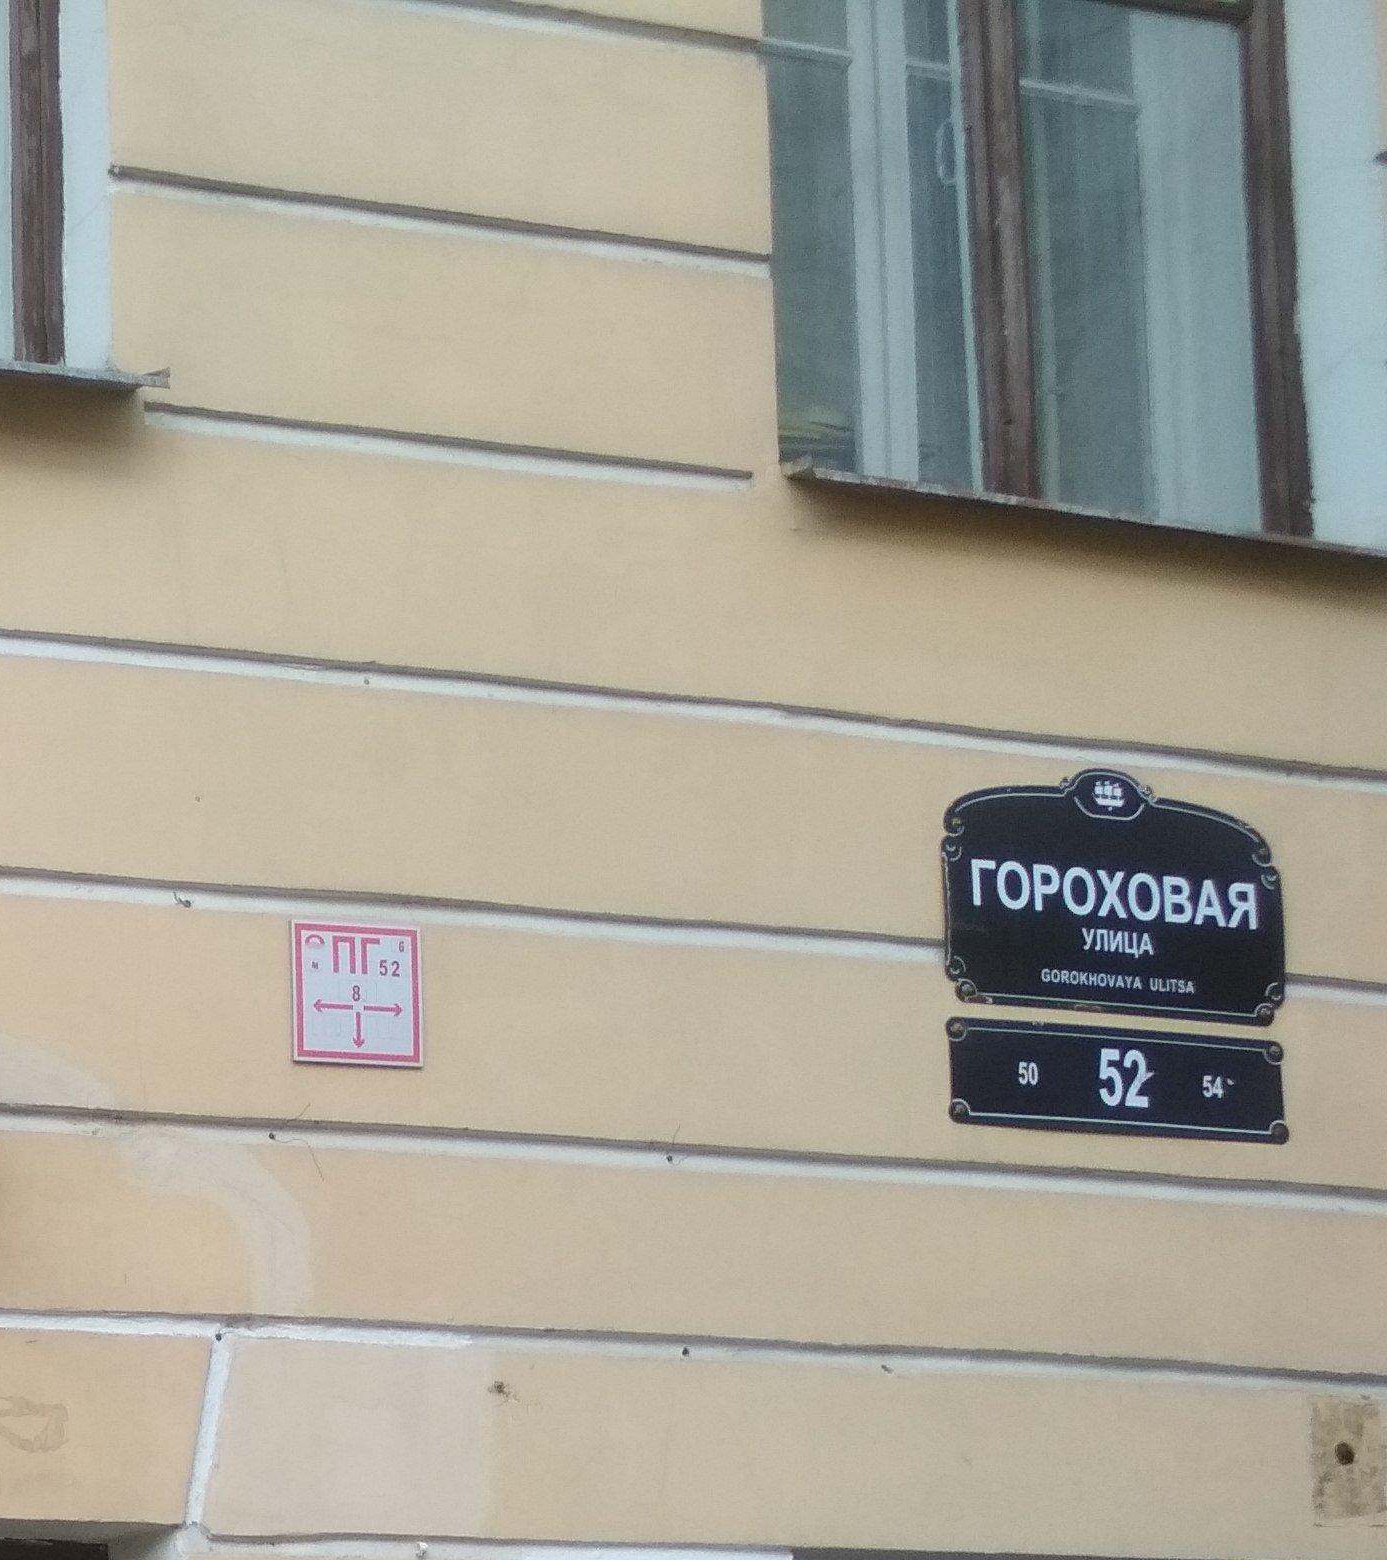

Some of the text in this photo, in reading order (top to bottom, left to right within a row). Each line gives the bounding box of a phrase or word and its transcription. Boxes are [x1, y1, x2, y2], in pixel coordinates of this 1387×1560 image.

[970, 859, 1258, 930] ГОРОХОВАЯ
[332, 935, 380, 974] ПГ
[1081, 928, 1154, 958] УЛИЦА
[379, 959, 401, 977] 52
[1041, 969, 1195, 994] GOROKHOVAYA ULITSA
[352, 985, 360, 1002] 8
[1018, 1061, 1038, 1086] 50
[1099, 1048, 1151, 1108] 52
